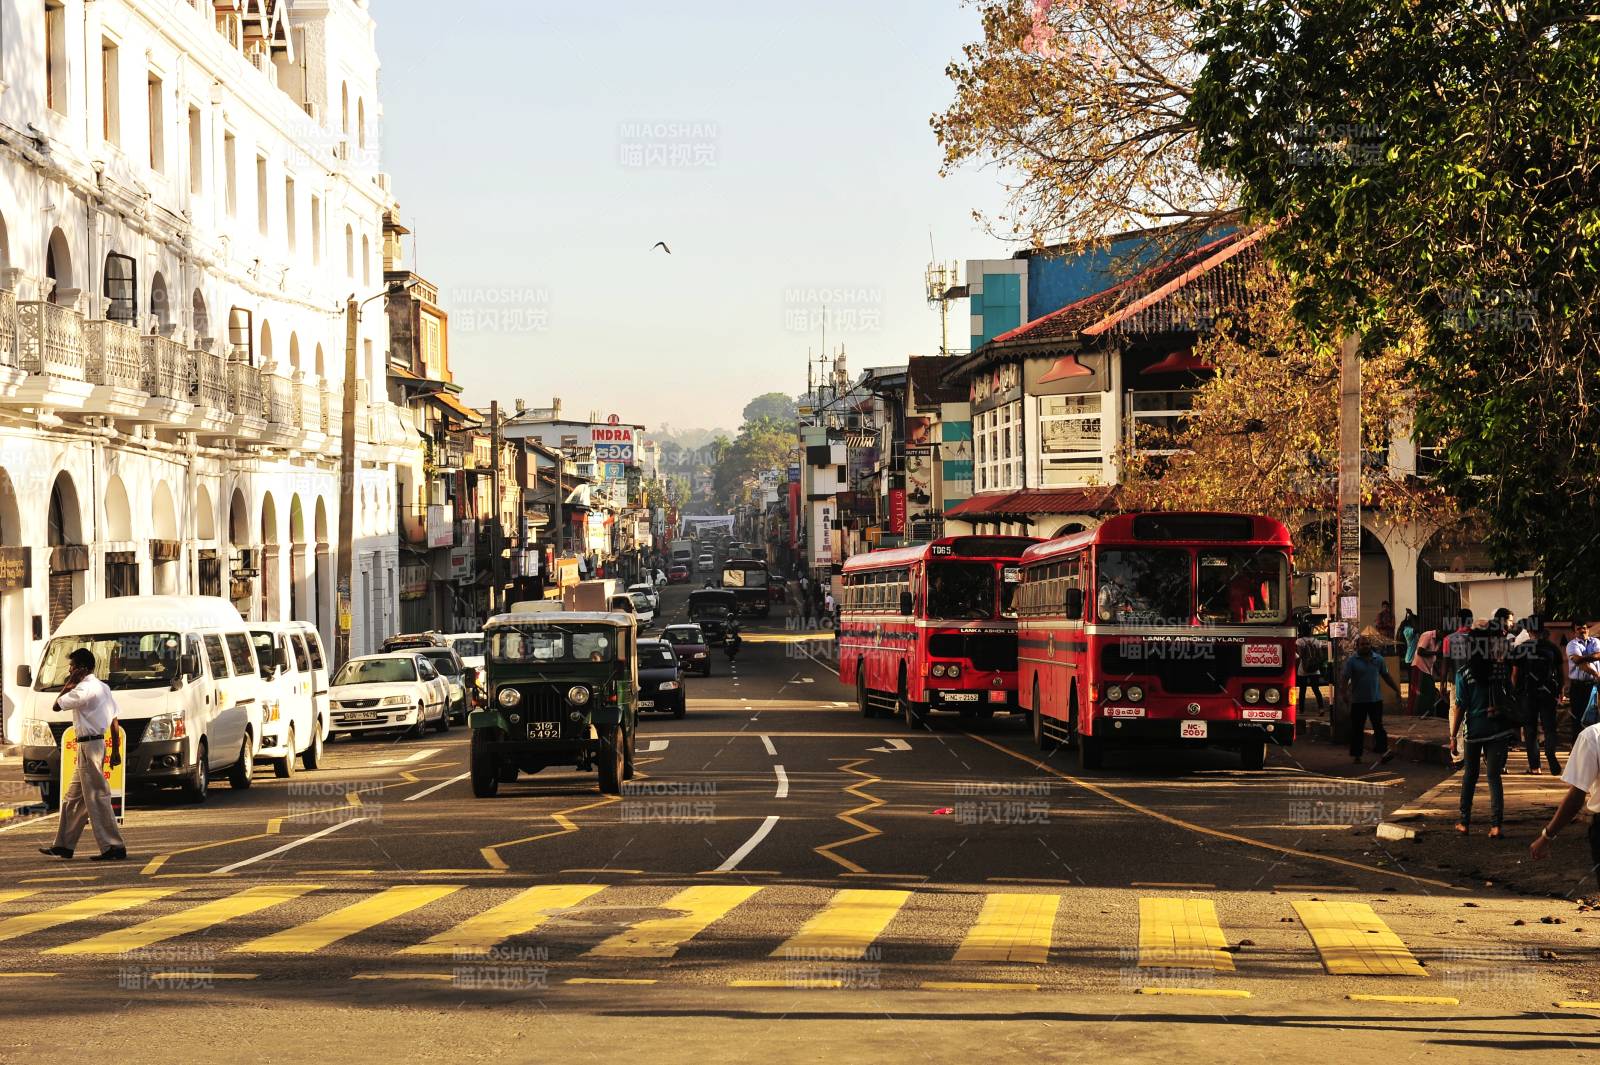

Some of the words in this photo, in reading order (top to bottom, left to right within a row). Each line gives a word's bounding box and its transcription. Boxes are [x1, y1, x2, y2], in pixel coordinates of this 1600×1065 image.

[592, 429, 631, 441] INDRA
[895, 501, 903, 532] TITAN
[932, 546, 952, 554] TD65
[529, 730, 558, 738] 5492
